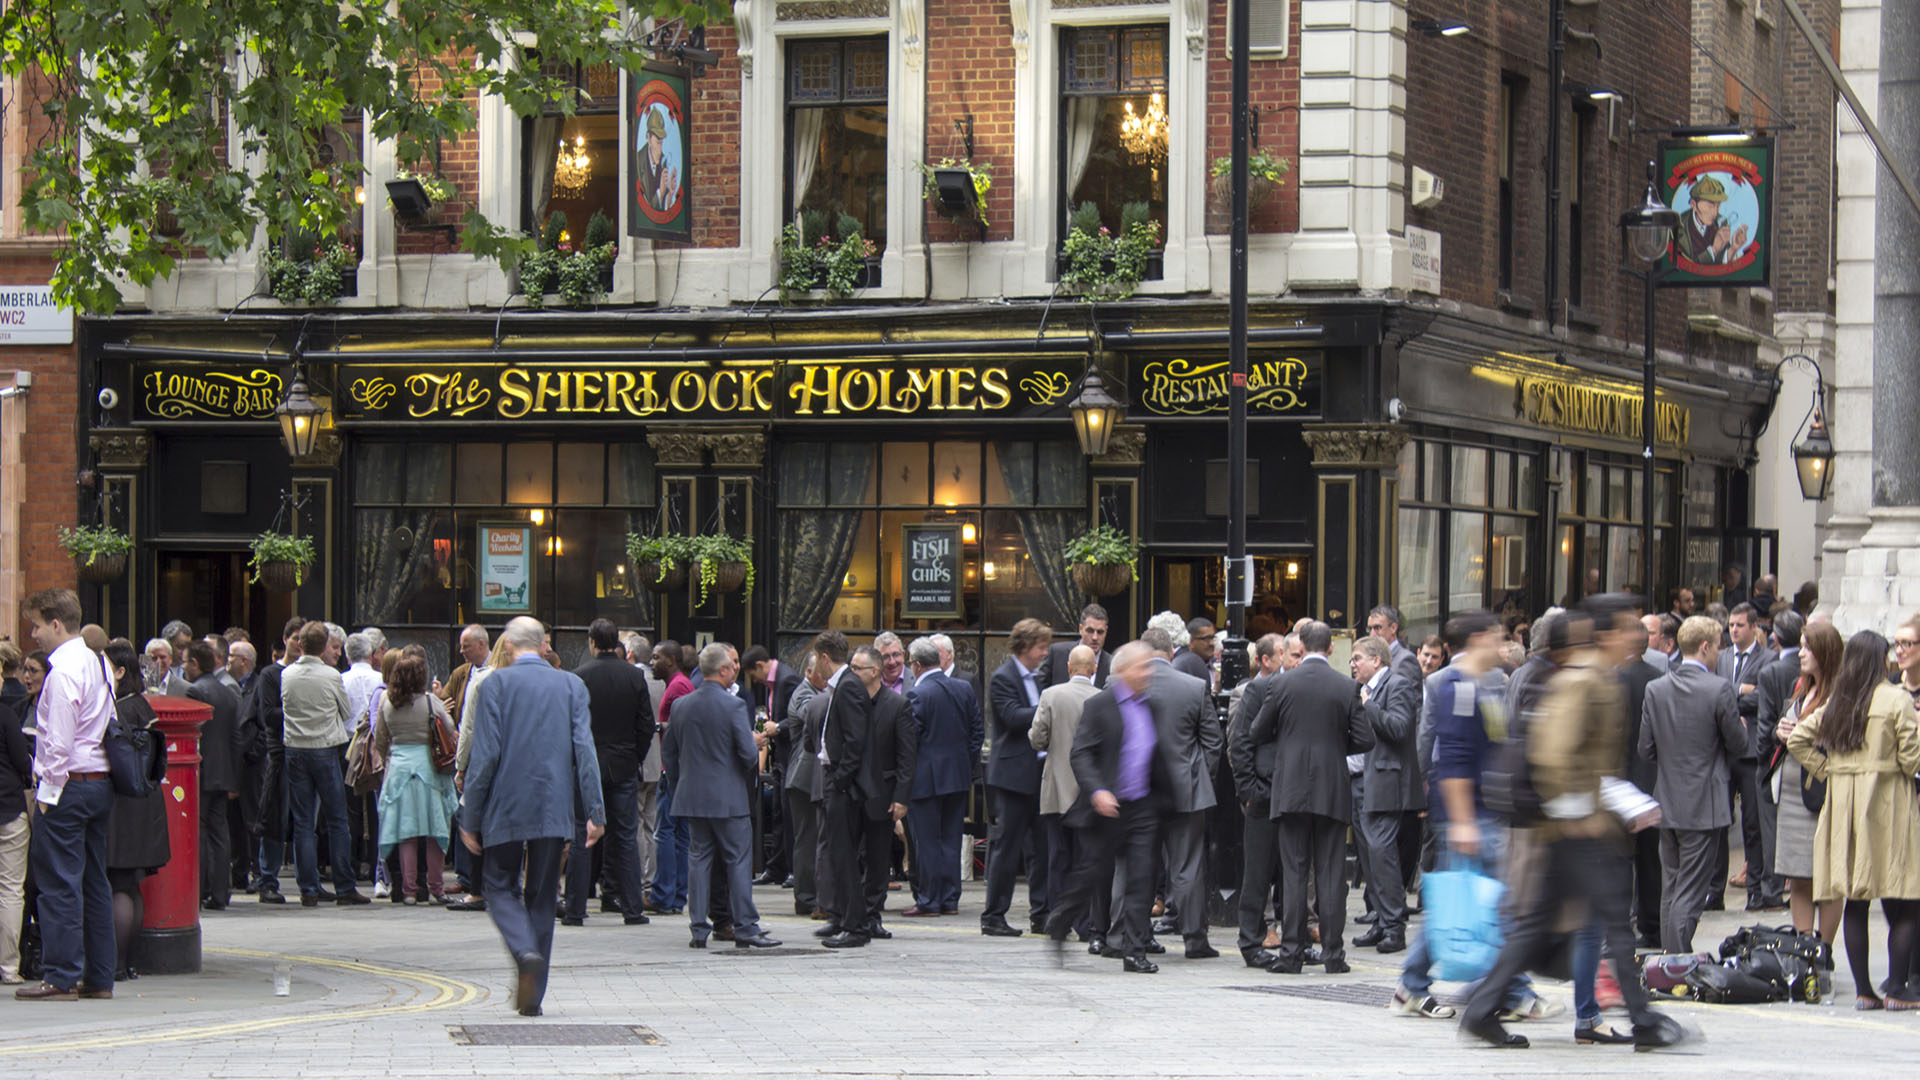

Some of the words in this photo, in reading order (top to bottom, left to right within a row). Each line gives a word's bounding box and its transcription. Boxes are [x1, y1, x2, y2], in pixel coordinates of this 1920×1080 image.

[1411, 251, 1429, 271] ASSAGE
[0, 292, 57, 307] MBERLAN
[0, 310, 25, 325] WC2
[153, 371, 230, 409] LOUNGE
[233, 385, 276, 416] BAR
[404, 371, 491, 417] The
[497, 368, 774, 418] SHERLOCK
[789, 366, 1012, 414] HOLMES
[1150, 361, 1297, 408] RESTAUANT
[1555, 382, 1625, 434] SHERLOCK
[1631, 397, 1680, 444] HOMES
[912, 538, 949, 560] FISH
[932, 553, 944, 569] &
[911, 567, 951, 582] CHIPS
